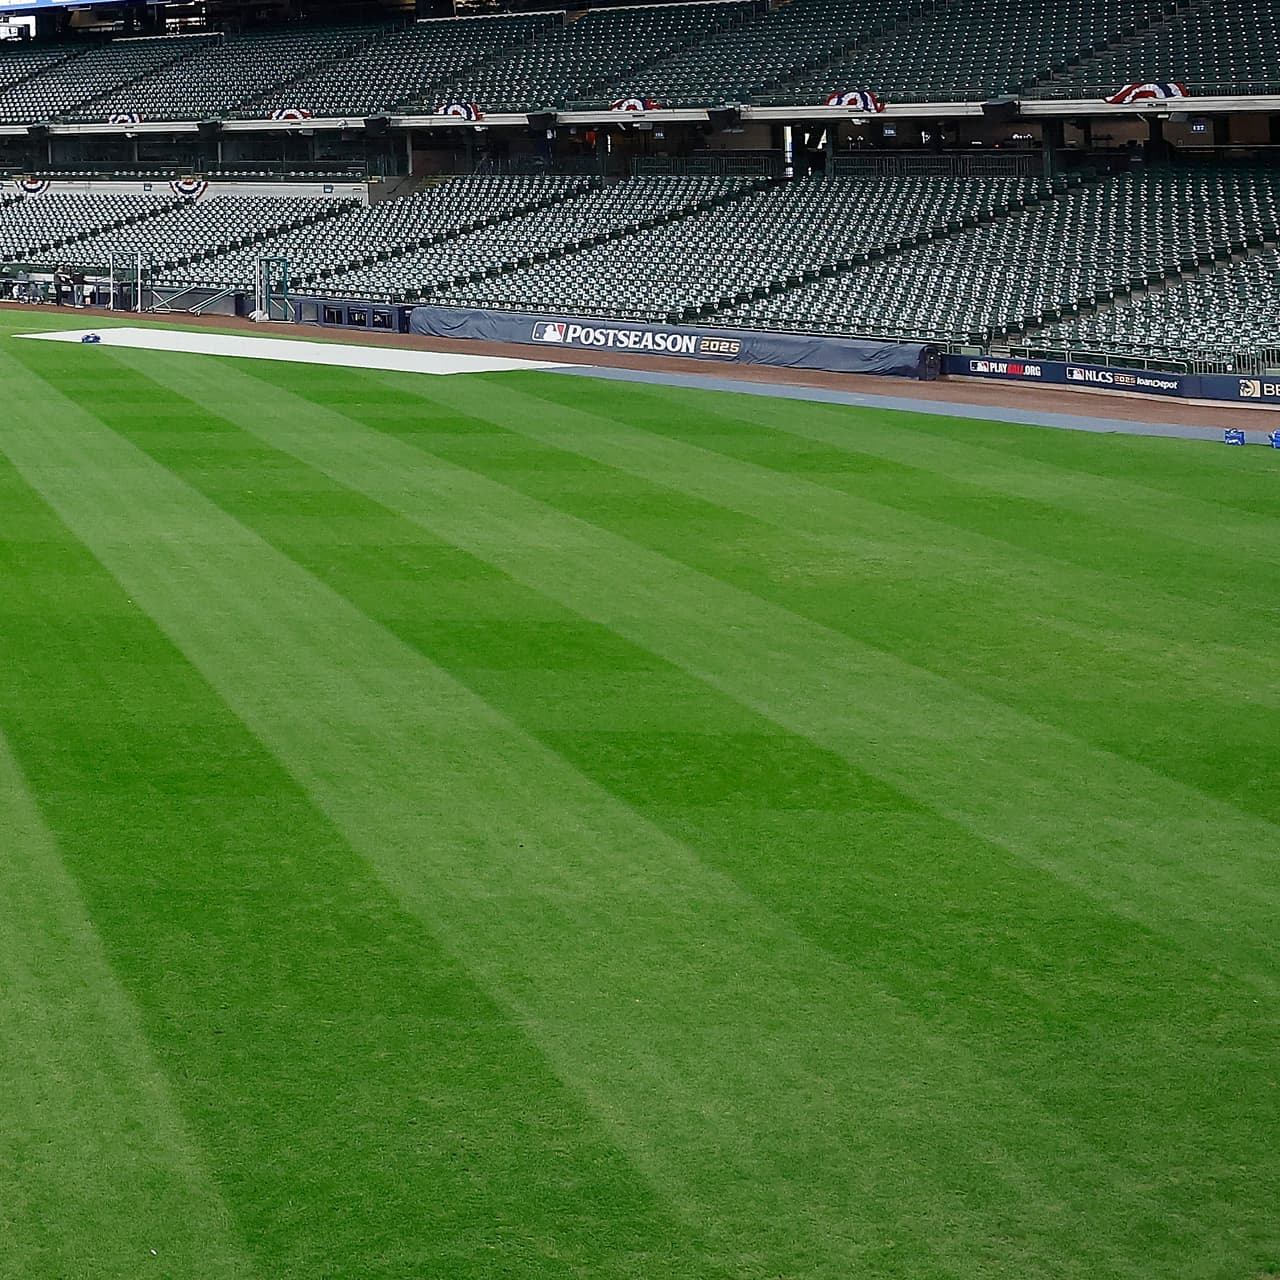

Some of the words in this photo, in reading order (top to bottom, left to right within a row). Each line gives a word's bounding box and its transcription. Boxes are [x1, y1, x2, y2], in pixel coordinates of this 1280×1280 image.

[565, 323, 697, 354] POSTSEASON
[699, 339, 740, 354] 2025
[1084, 370, 1113, 384] NLCS
[1136, 376, 1178, 391] loanDepot
